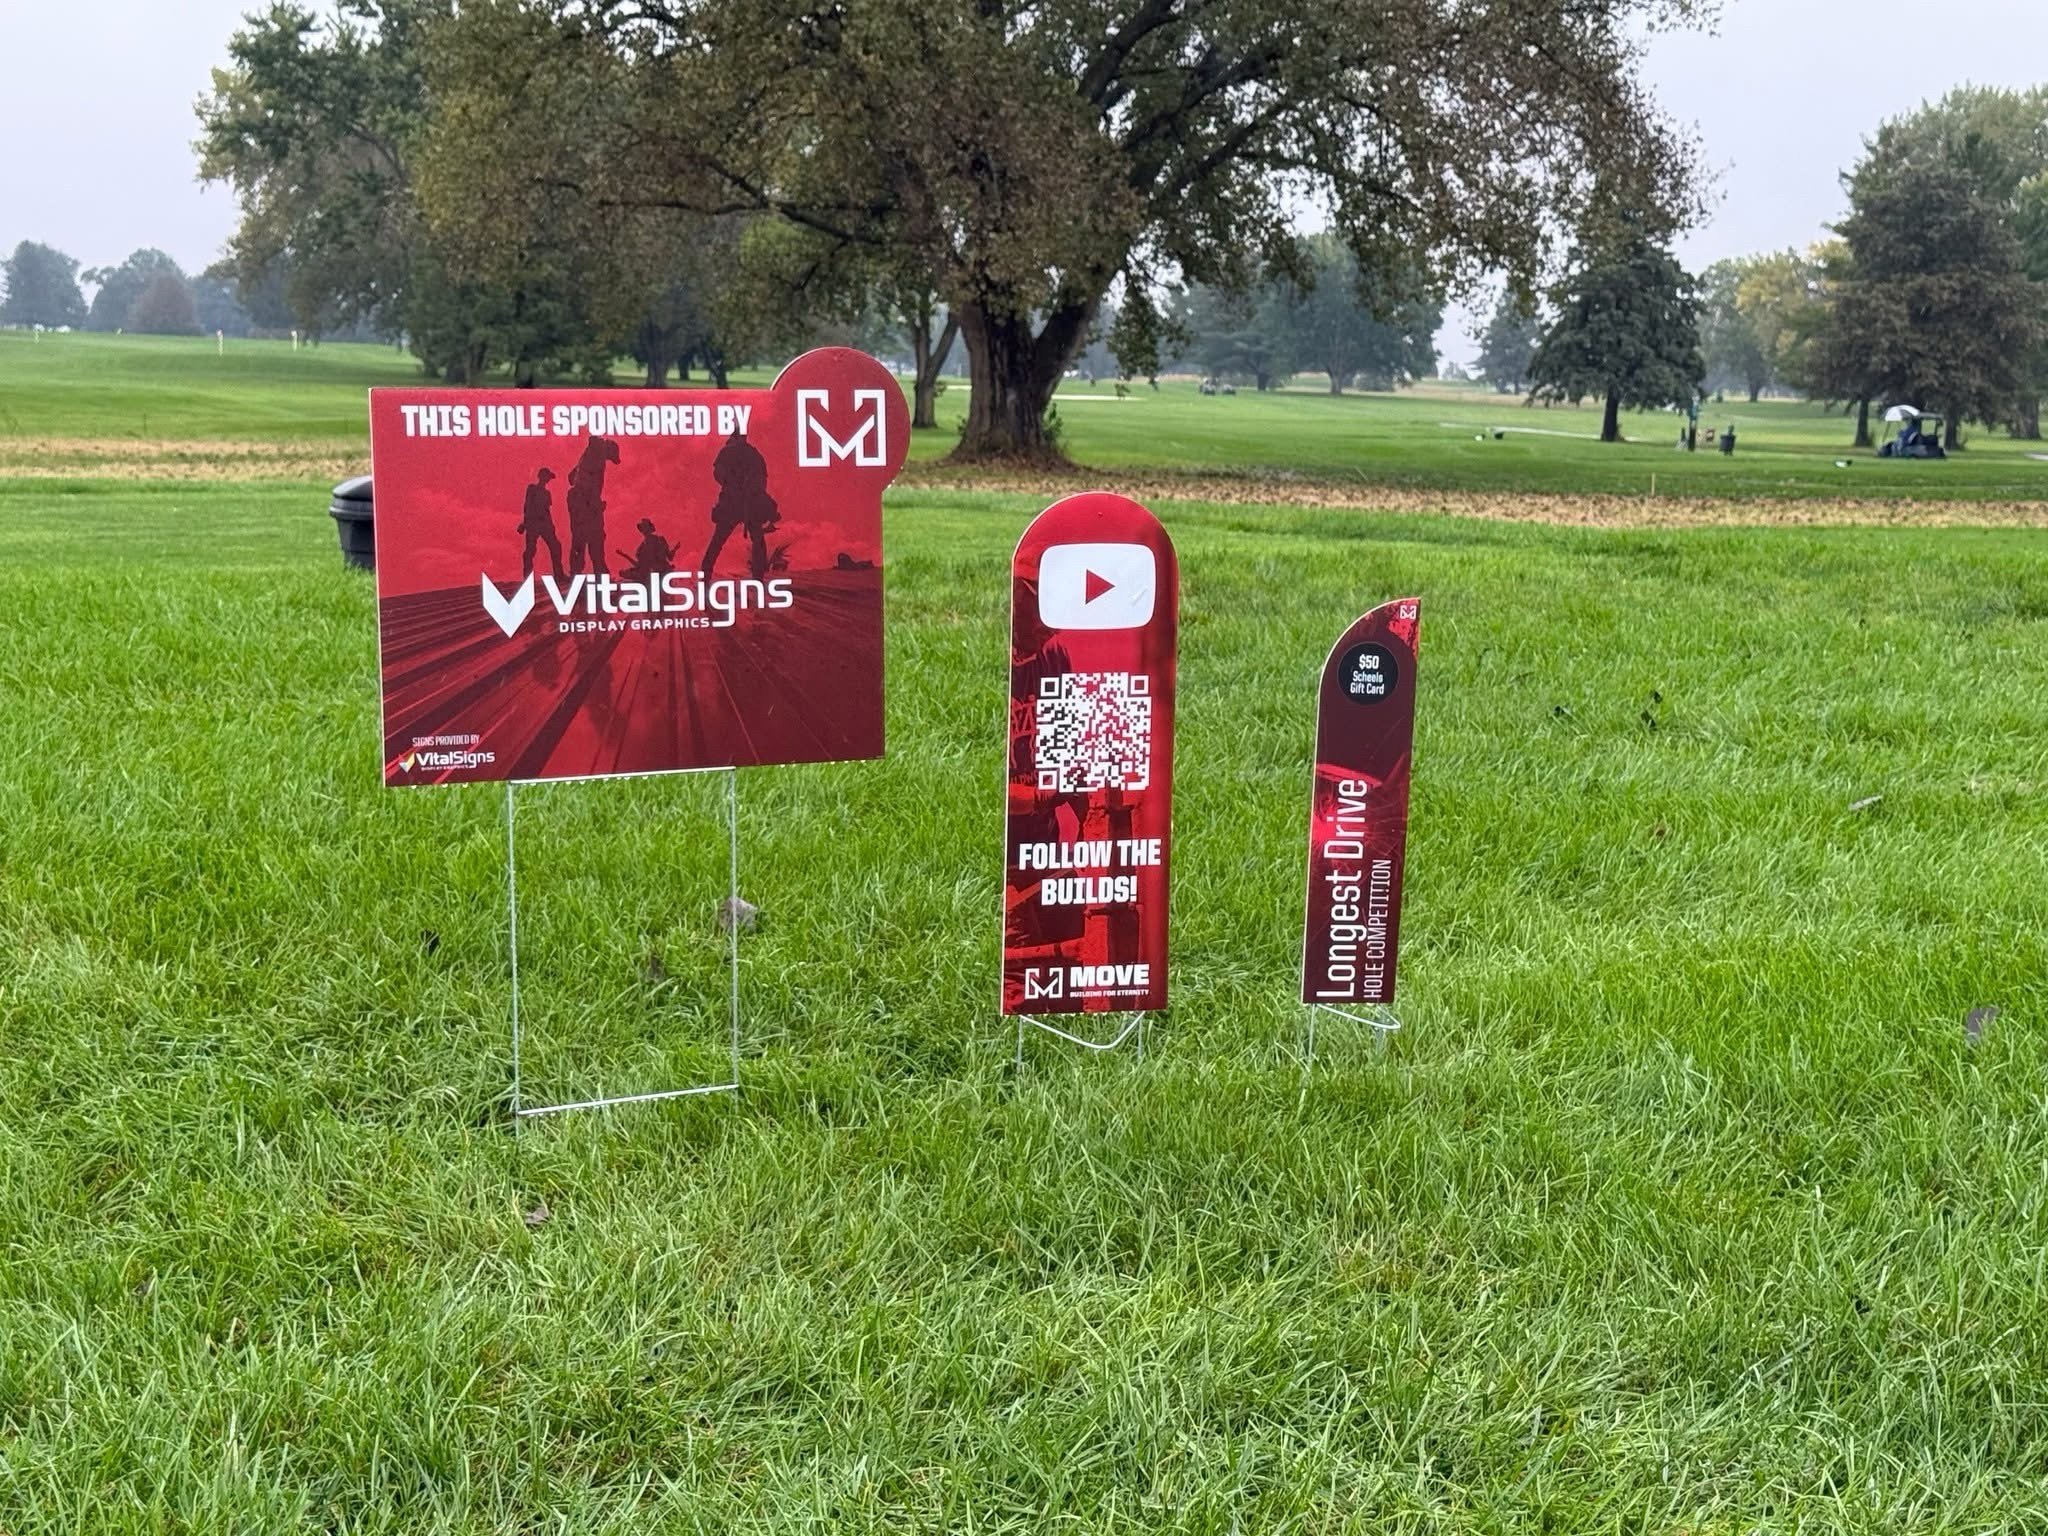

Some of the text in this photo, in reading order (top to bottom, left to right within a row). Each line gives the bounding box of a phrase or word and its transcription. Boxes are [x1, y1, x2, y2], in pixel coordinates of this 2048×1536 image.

[401, 405, 751, 437] THIS HOLE SPONSORED BY
[541, 571, 793, 627] VitalSigns
[559, 617, 710, 633] DISPLAY GRAPHICS
[1359, 654, 1380, 669] $50
[1350, 682, 1385, 694] Gift Card
[412, 734, 480, 748] SIGNS PROVIDED BY
[416, 751, 496, 769] VitalSigns
[1019, 839, 1161, 870] FOLLOW THE
[1041, 875, 1137, 906] BUILDS!
[1316, 779, 1367, 997] Longest Drive
[1363, 859, 1392, 998] HOLE COMPETITION
[1069, 964, 1150, 987] MOVE
[1069, 990, 1102, 998] BUILDING
[1117, 989, 1149, 997] ETERNITY
